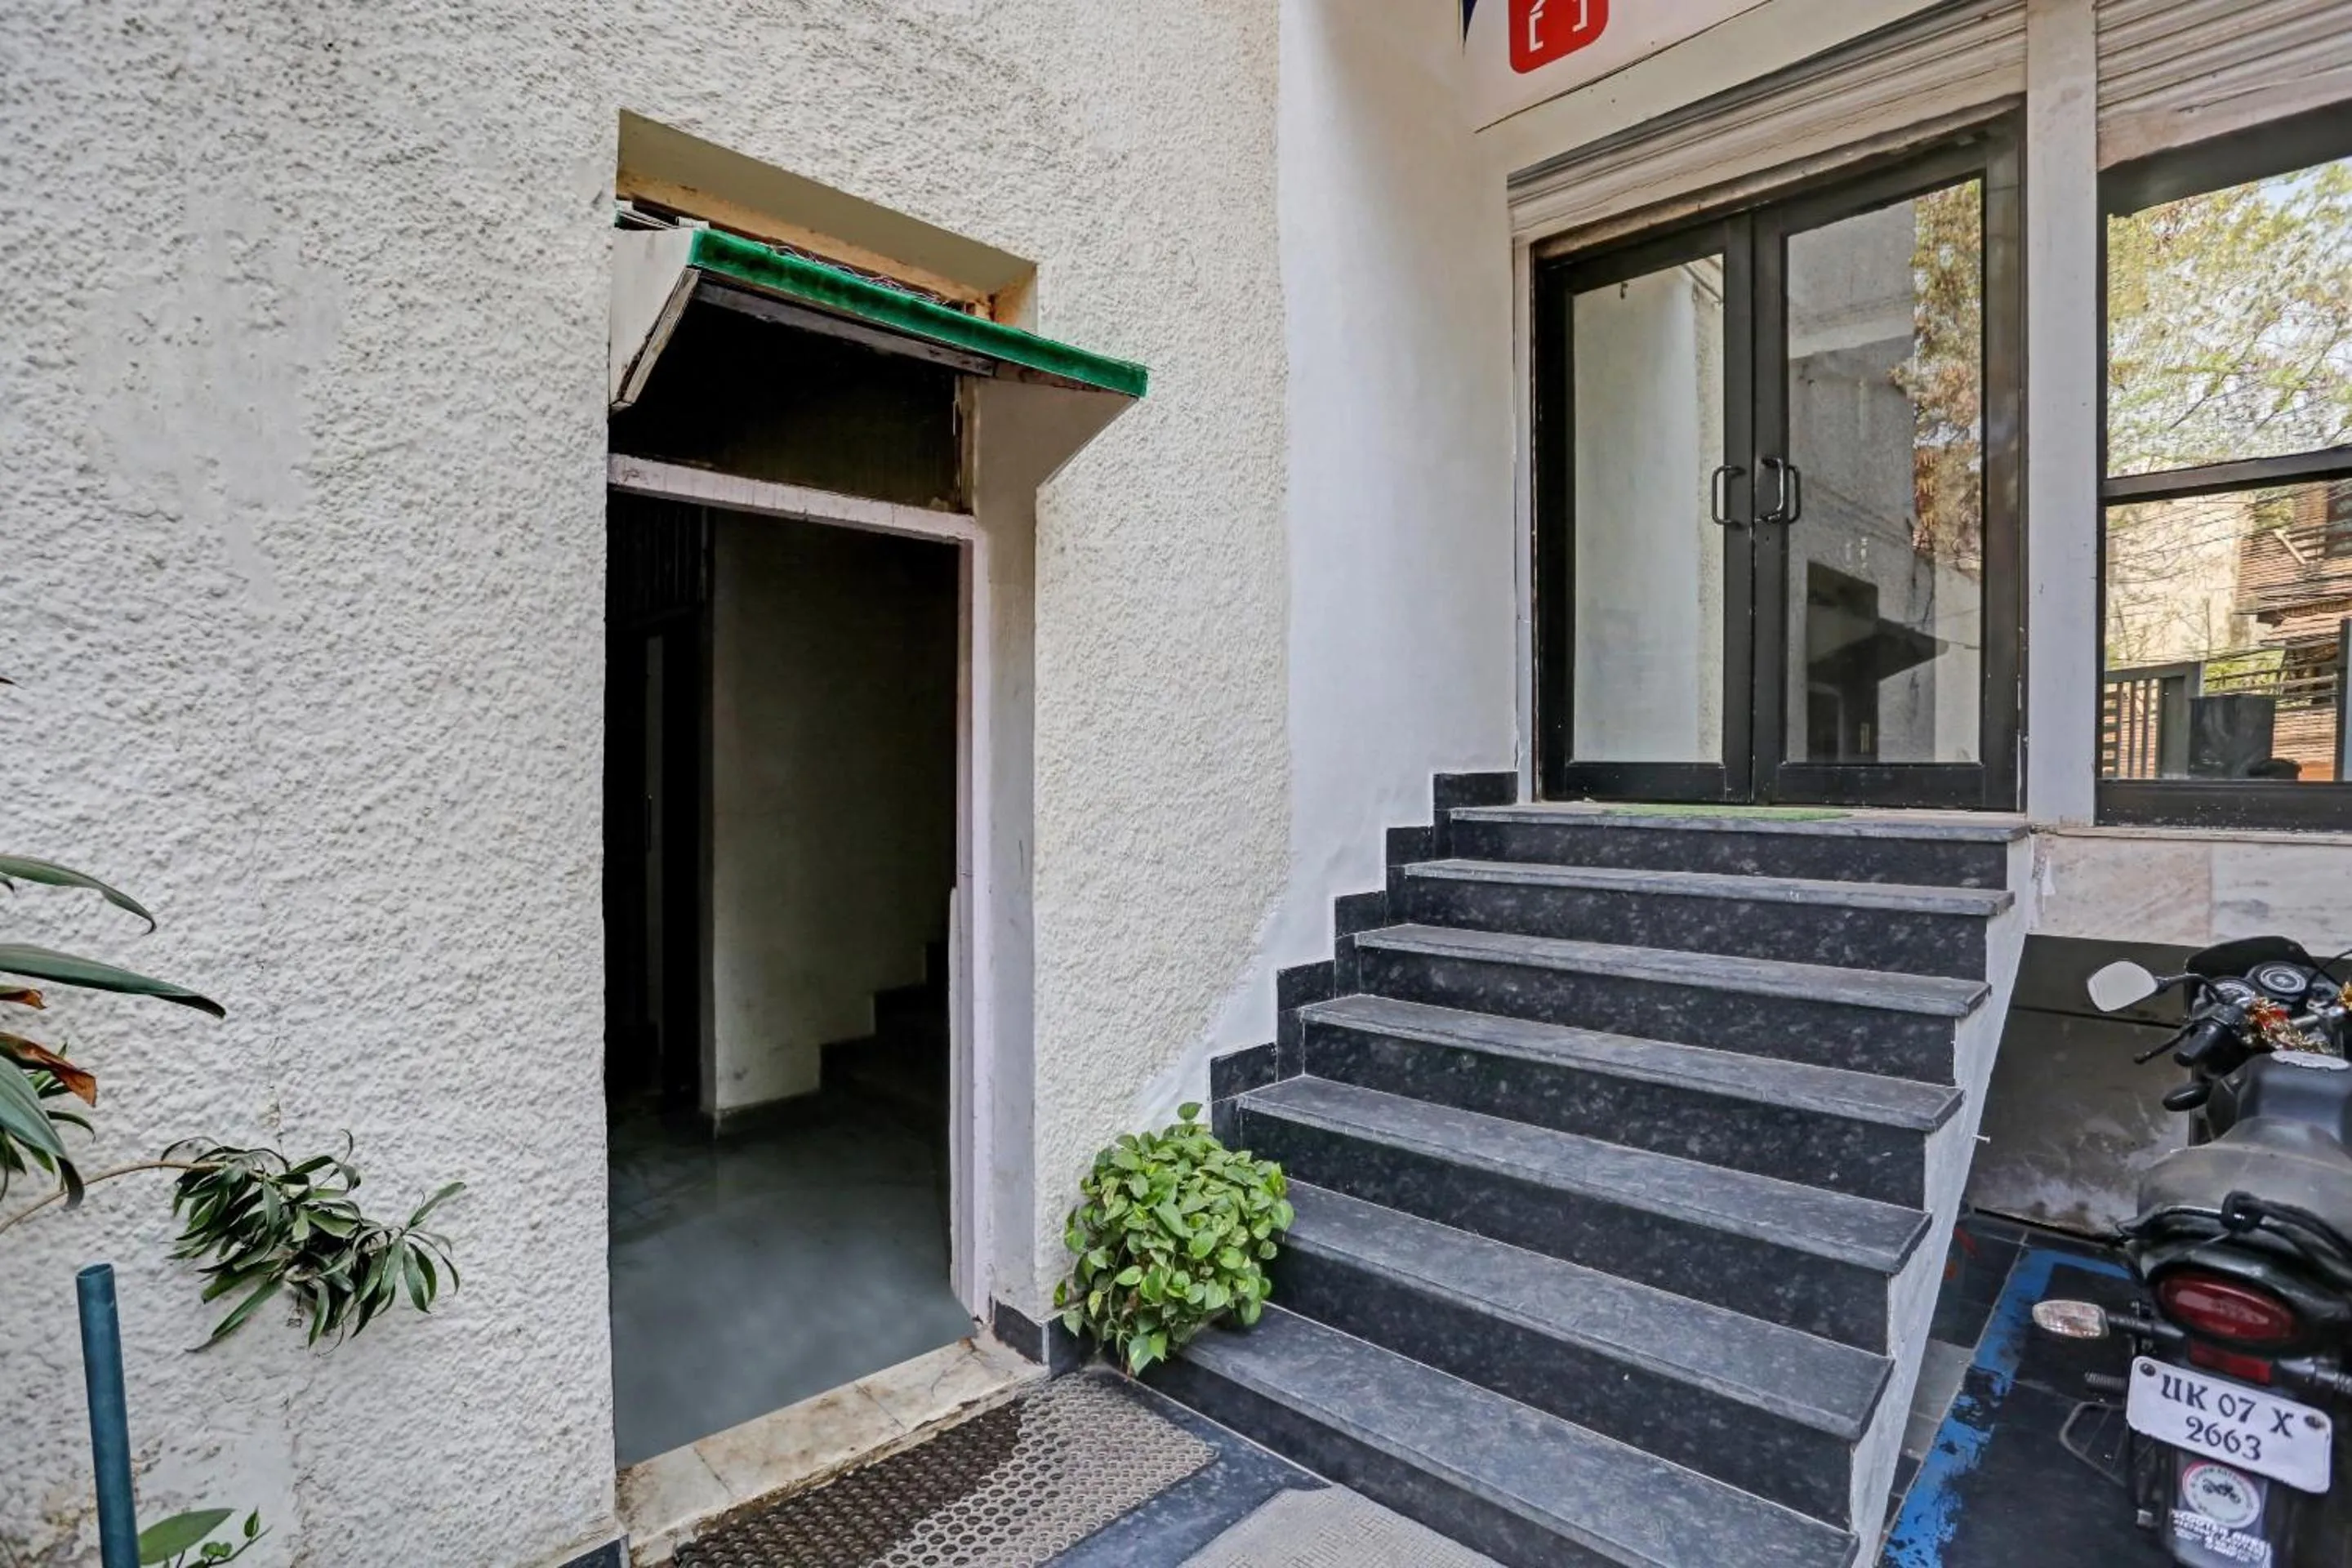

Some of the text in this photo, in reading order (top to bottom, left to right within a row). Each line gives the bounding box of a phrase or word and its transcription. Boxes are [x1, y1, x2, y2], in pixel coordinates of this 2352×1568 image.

[2161, 1374, 2295, 1438] UK 07 X
[2185, 1415, 2261, 1461] 2663
